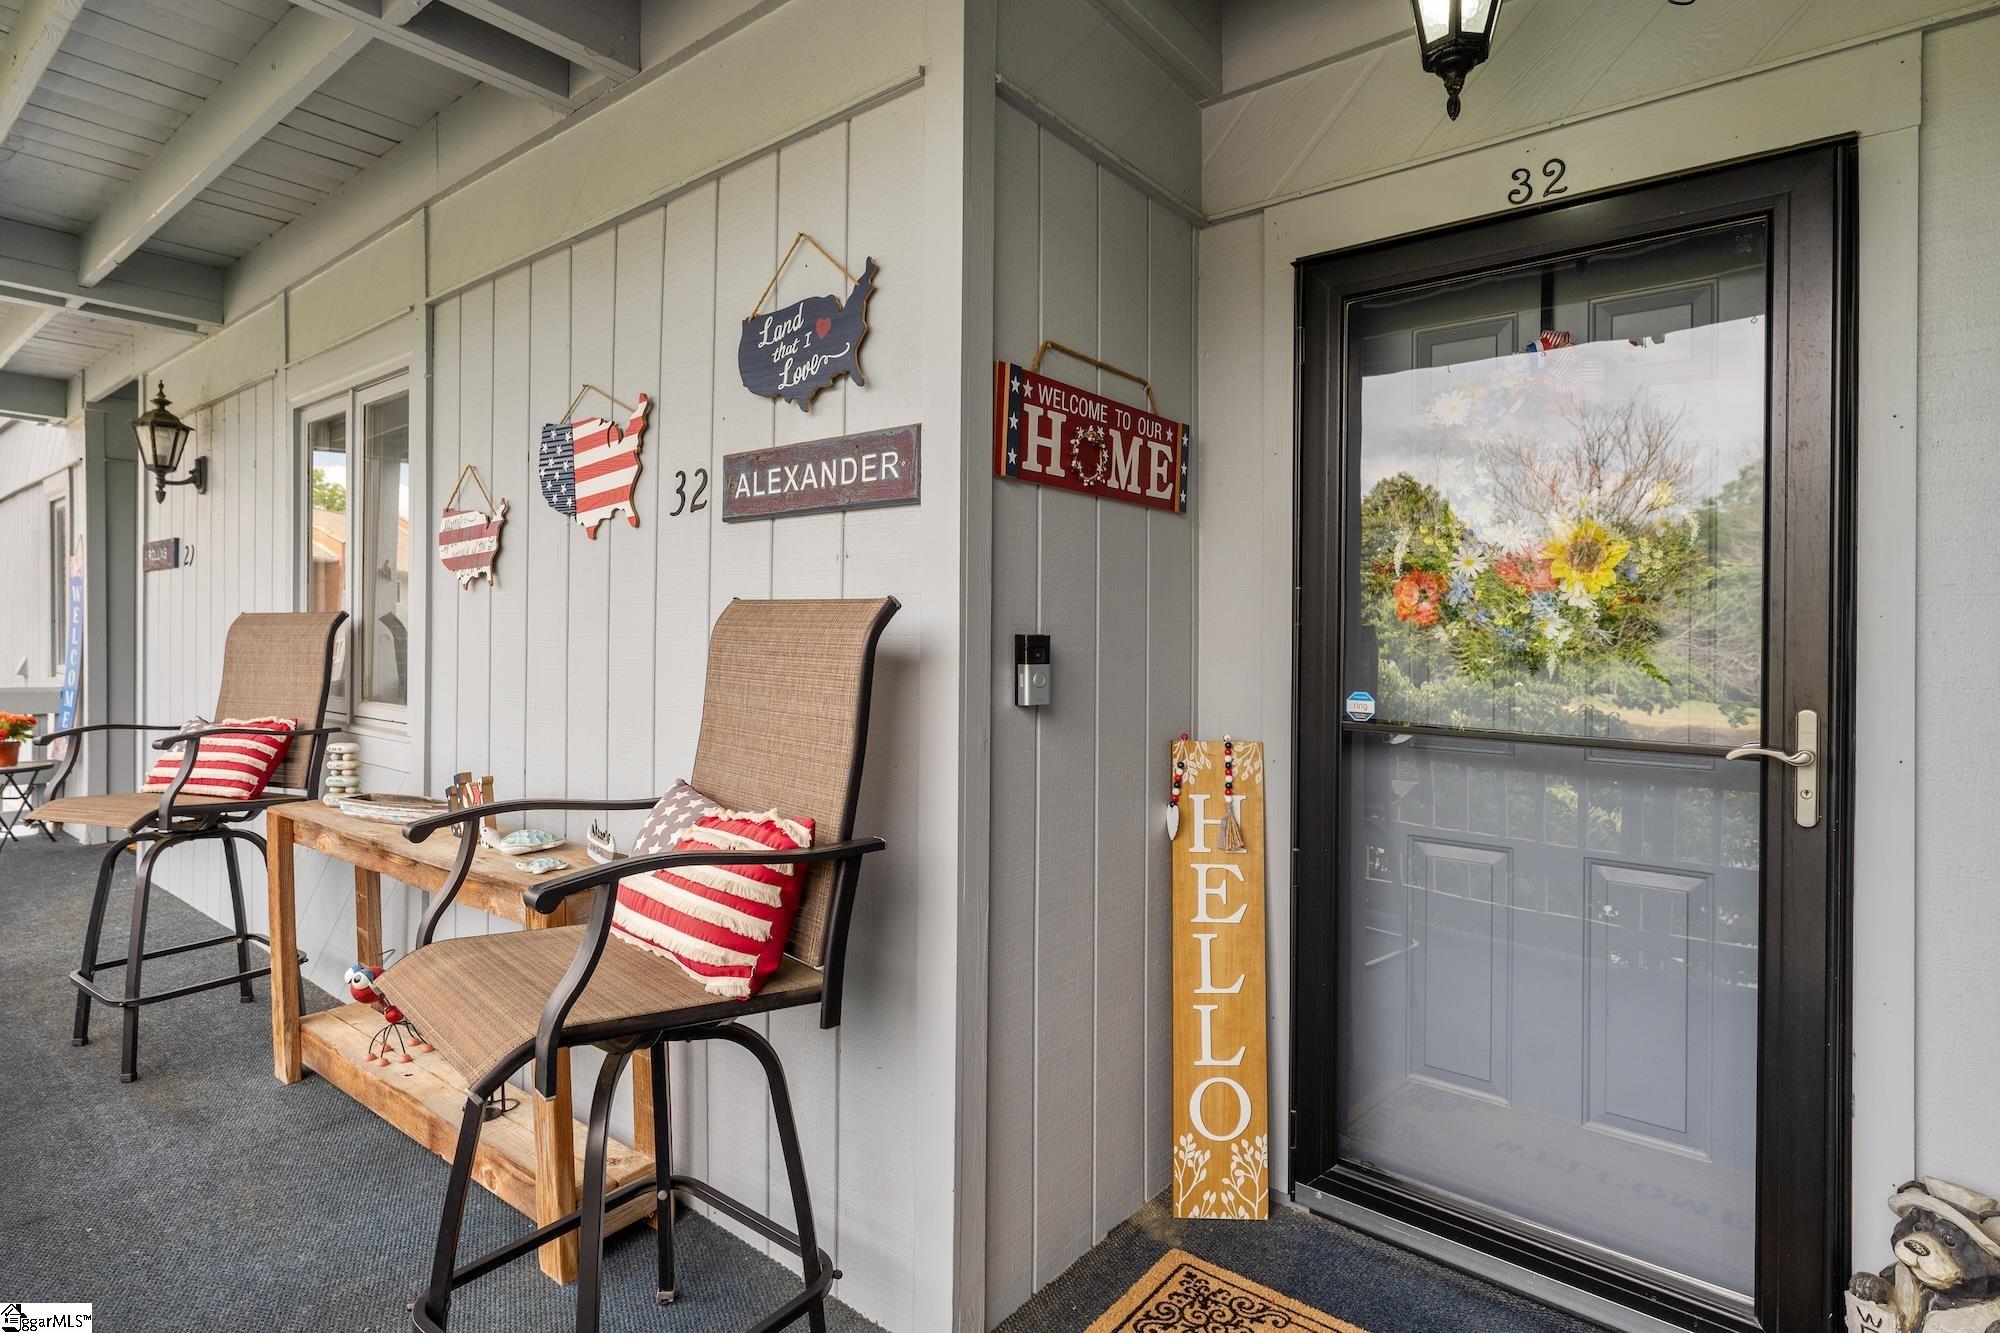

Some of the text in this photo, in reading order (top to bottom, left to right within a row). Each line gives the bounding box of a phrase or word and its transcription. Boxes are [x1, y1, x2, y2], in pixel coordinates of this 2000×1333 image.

[1507, 158, 1568, 204] 32
[758, 302, 804, 348] Land
[772, 331, 812, 363] that I
[1038, 383, 1163, 441] WELCOME TO OUR
[735, 451, 899, 499] ALEXANDER
[1022, 403, 1173, 500] HOME
[670, 468, 708, 516] 32
[61, 585, 82, 729] WELCOME
[1188, 794, 1252, 1142] HELLO
